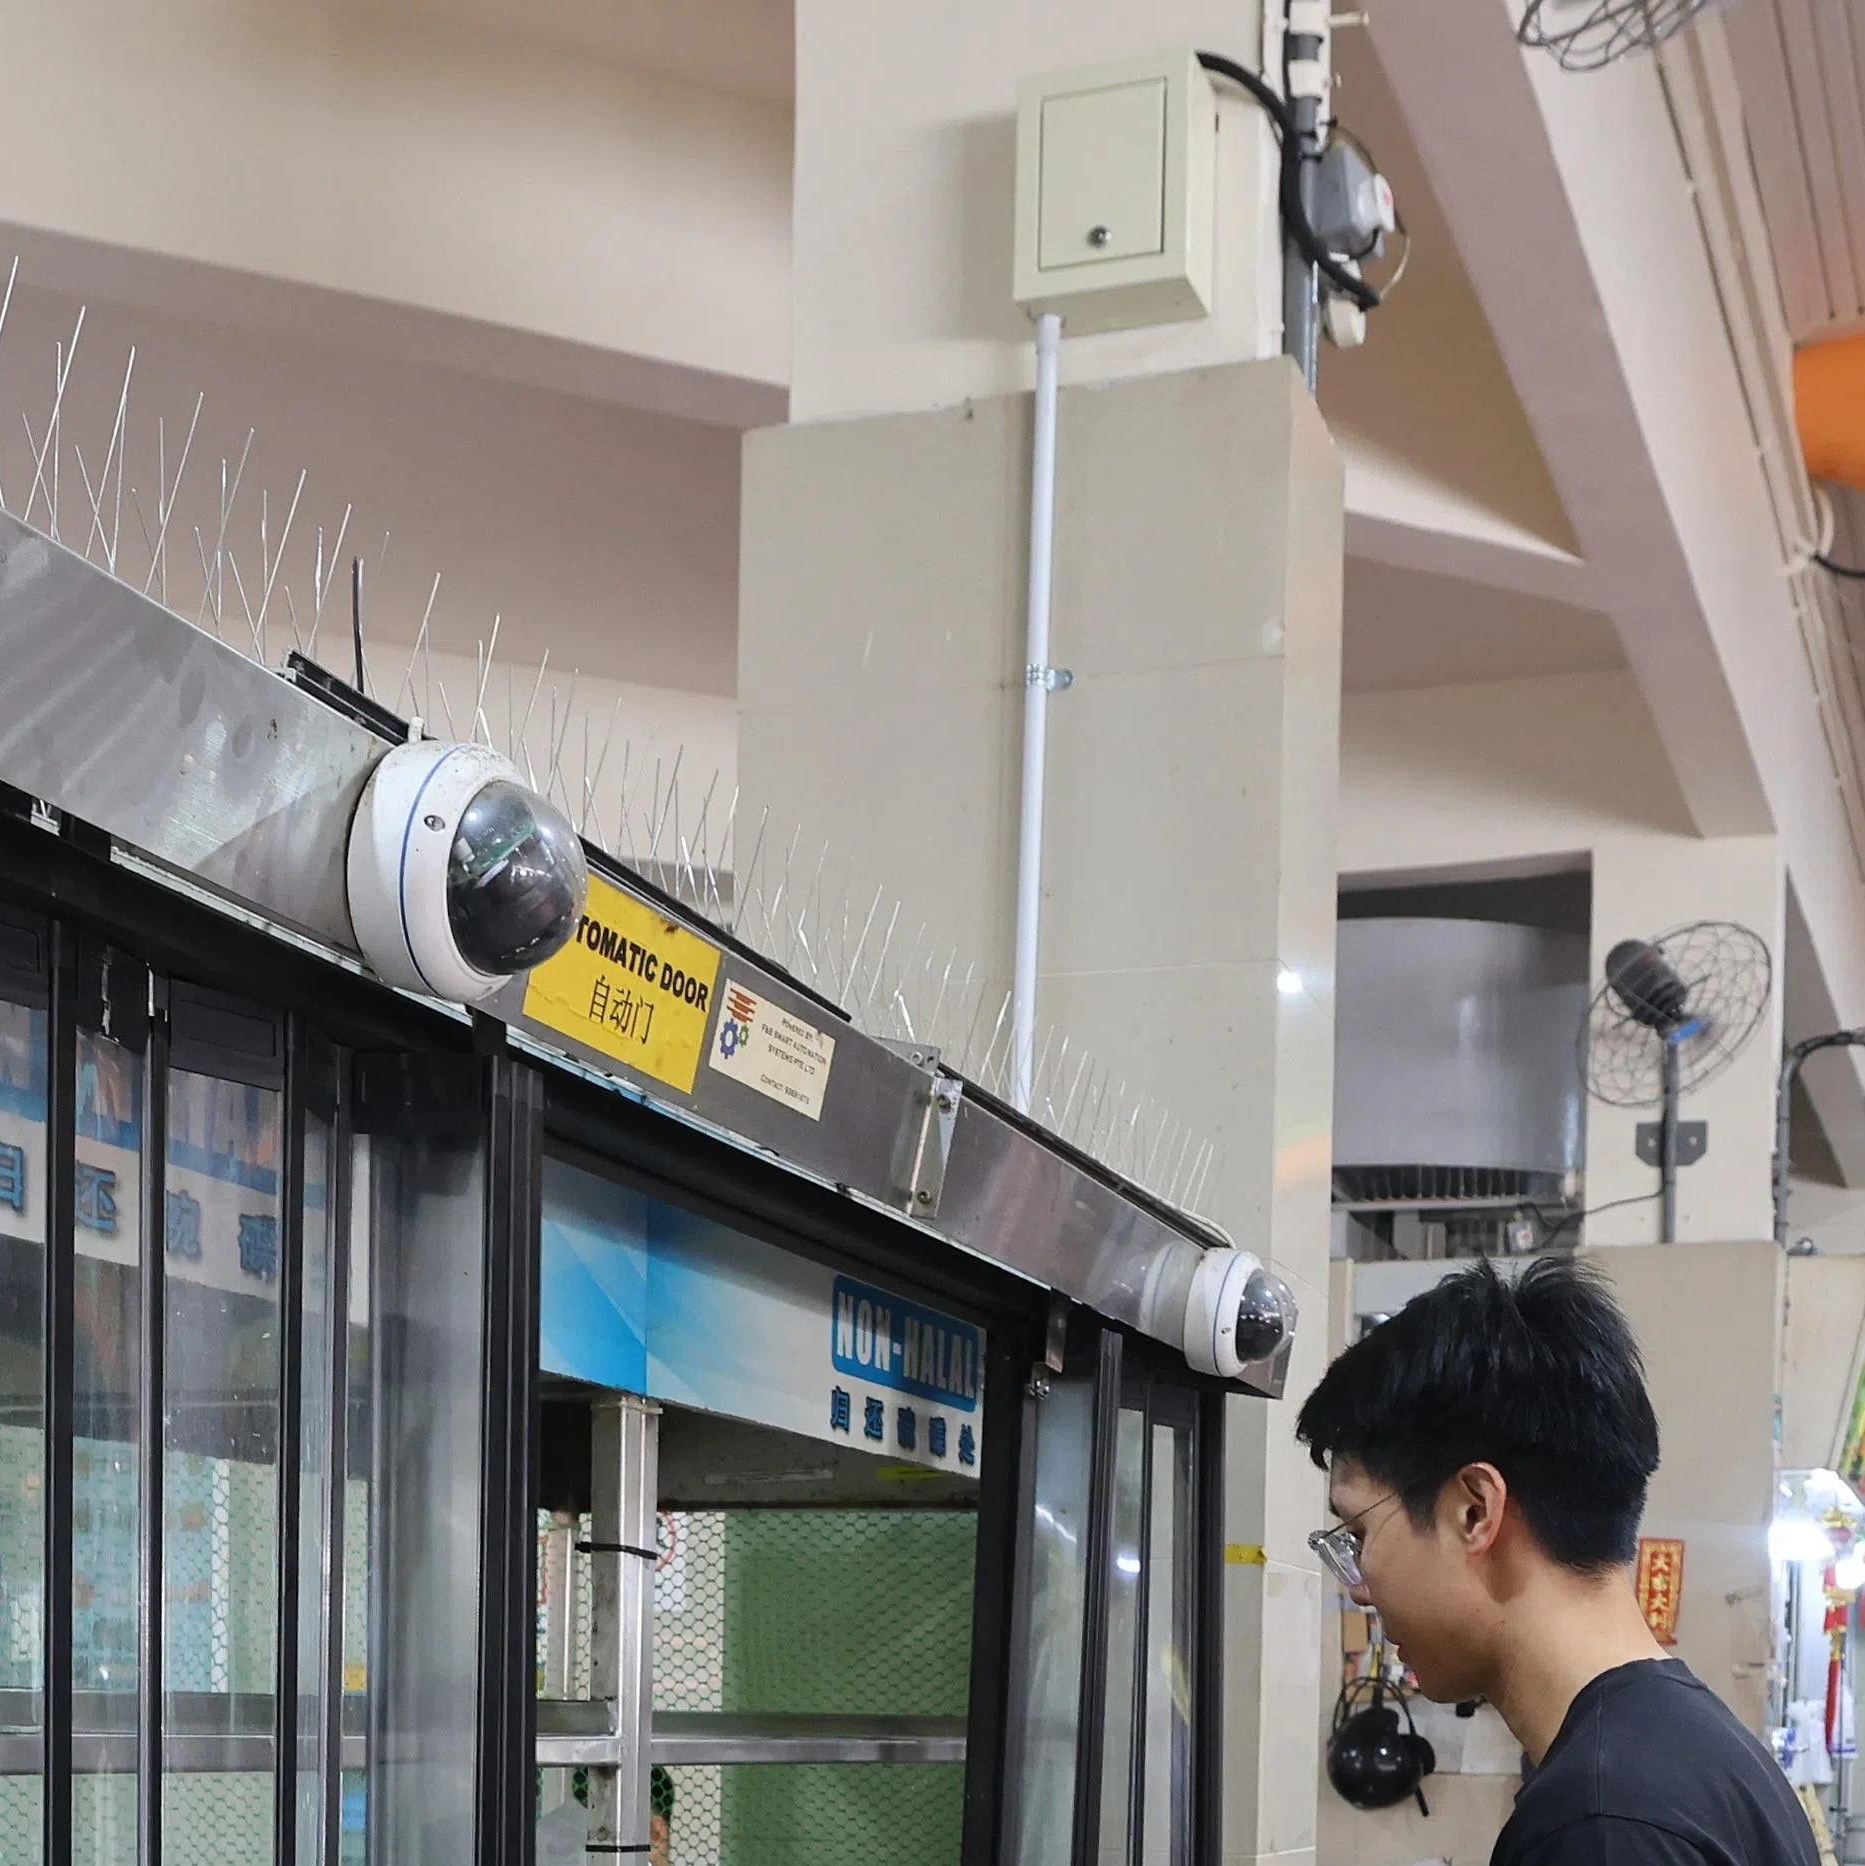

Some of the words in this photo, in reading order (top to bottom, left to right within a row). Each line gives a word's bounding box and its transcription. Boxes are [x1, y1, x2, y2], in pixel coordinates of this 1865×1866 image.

[576, 914, 658, 983] TOMATIC
[659, 961, 709, 1012] DOOR
[589, 974, 654, 1045] 自动门
[793, 1039, 827, 1065] AUTOMATION
[837, 1291, 975, 1400] NON-HALAL
